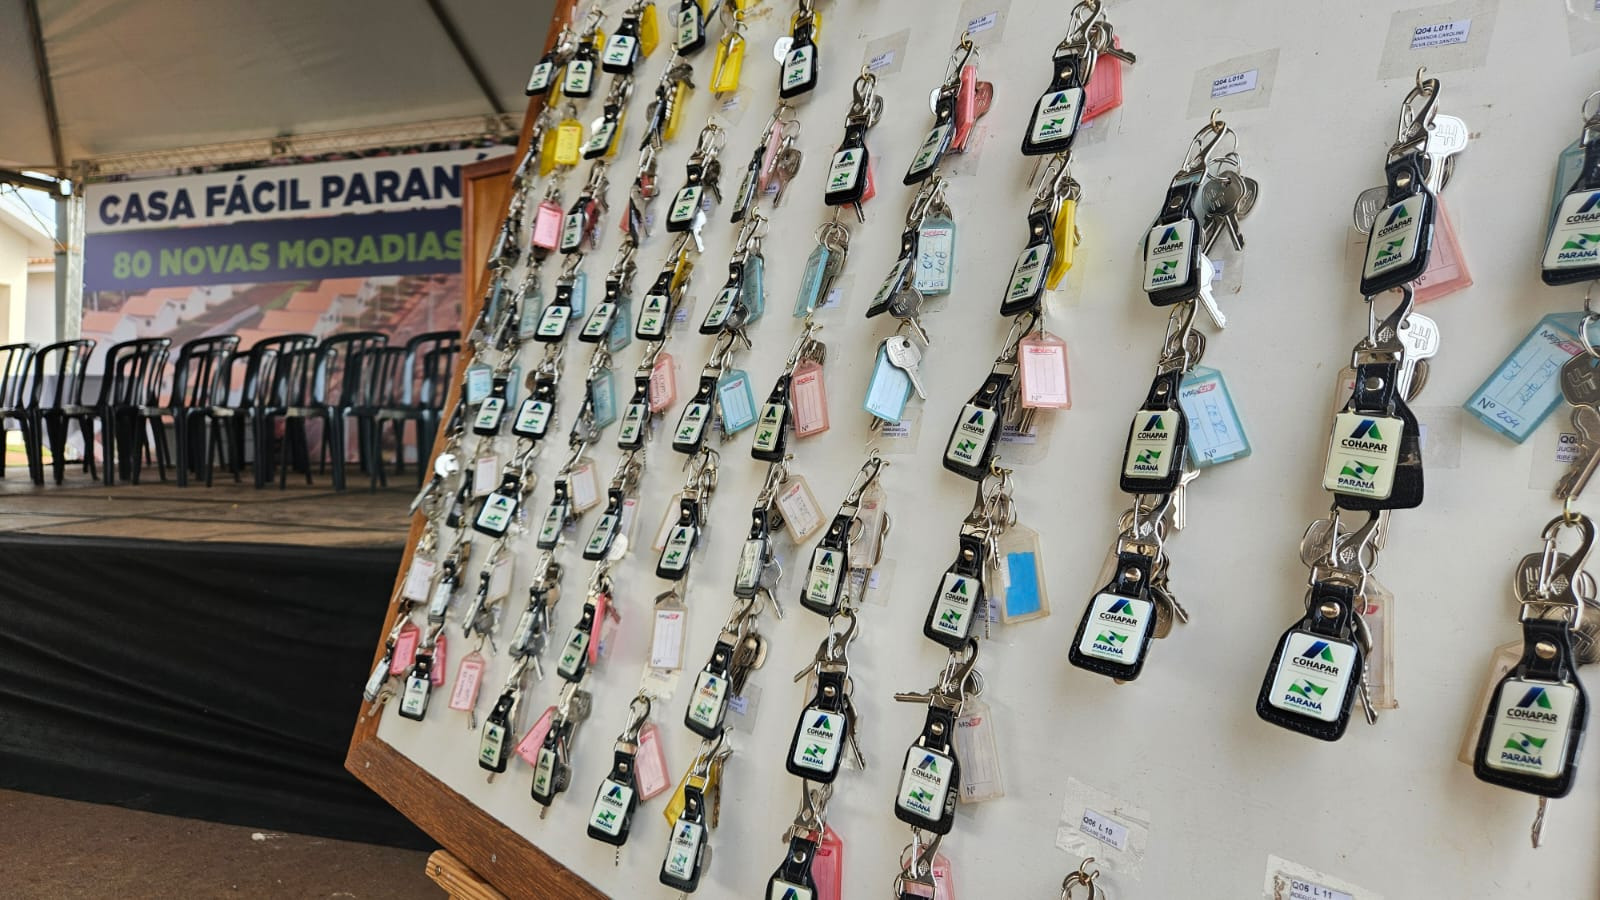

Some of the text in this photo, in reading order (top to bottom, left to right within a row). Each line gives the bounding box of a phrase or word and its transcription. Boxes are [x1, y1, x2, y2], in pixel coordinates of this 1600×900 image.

[1042, 103, 1071, 114] COHAPAR
[99, 154, 488, 225] CASA FÁCIL PARAN
[1566, 212, 1600, 222] COHAP
[1377, 217, 1412, 236] COHAPAR
[1152, 241, 1183, 254] COHAPAR
[113, 229, 464, 279] 80 NOVAS MORADIAS
[1374, 251, 1402, 268] PARANÁ
[1557, 249, 1598, 260] PARANÁ
[1151, 274, 1176, 283] PARANÁ
[963, 423, 985, 435] COHAPAR
[1137, 432, 1168, 440] COHAPAR
[1341, 439, 1388, 451] COHAPAR
[954, 450, 972, 460] PARANÁ
[1337, 477, 1375, 489] PARANÁ
[945, 592, 968, 603] COHAPAR
[1099, 612, 1138, 625] COHAPAR
[938, 621, 958, 631] PARANÁ
[1092, 643, 1123, 655] PARANÁ
[1292, 656, 1339, 675] COHAPAR
[1285, 694, 1322, 711] PARANÁ
[1507, 708, 1558, 722] COHAPAR
[807, 727, 833, 739] COHAPAR
[802, 755, 824, 766] PARANÁ
[1501, 752, 1542, 766] PARANÁ
[911, 767, 942, 784] COHAPAR
[906, 798, 930, 812] PARANÁ
[1314, 887, 1320, 896] L
[1323, 890, 1332, 899] 11
